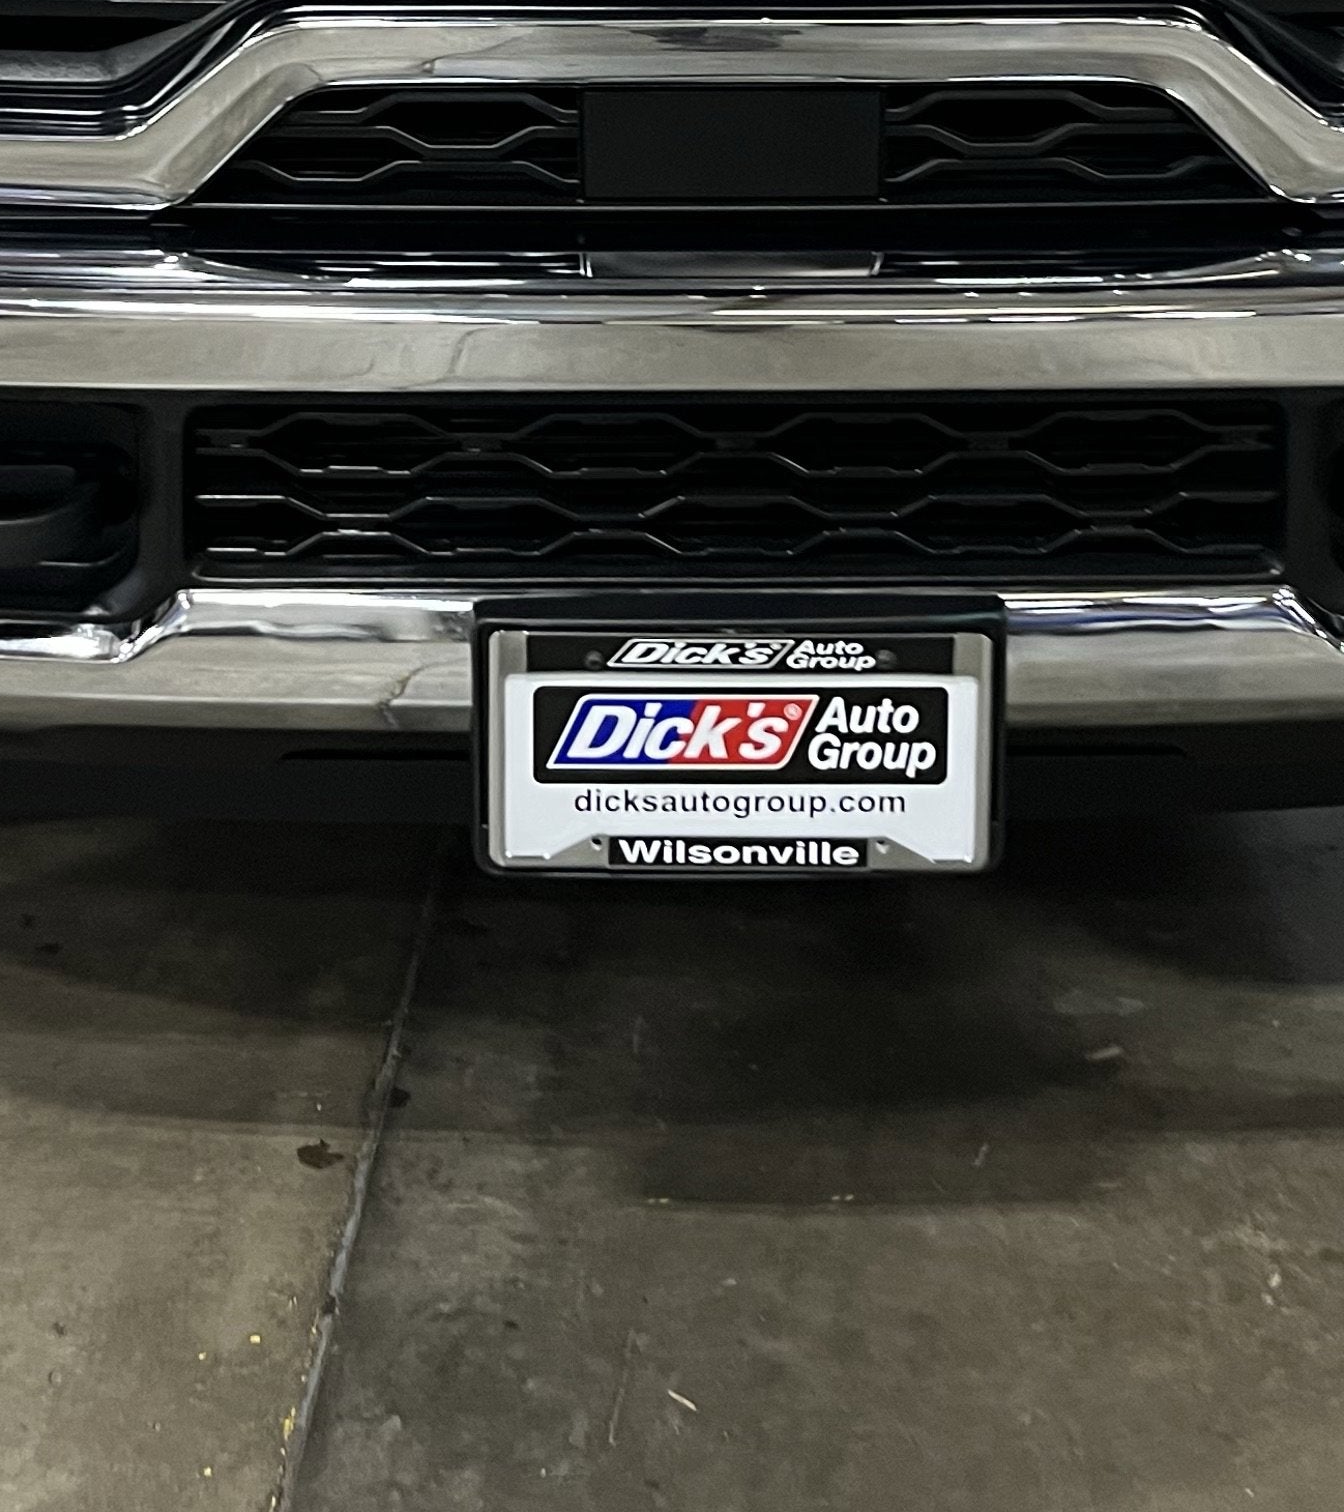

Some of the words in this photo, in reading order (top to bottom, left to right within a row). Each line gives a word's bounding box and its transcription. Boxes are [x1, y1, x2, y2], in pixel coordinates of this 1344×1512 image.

[621, 641, 773, 664] Dick's
[795, 639, 864, 655] Auto
[786, 653, 877, 671] Group
[815, 696, 920, 735] Auto
[567, 702, 788, 760] Dick's
[807, 733, 937, 779] Group
[574, 790, 906, 818] dicksautogroup.com
[618, 839, 860, 866] Wilsonville
